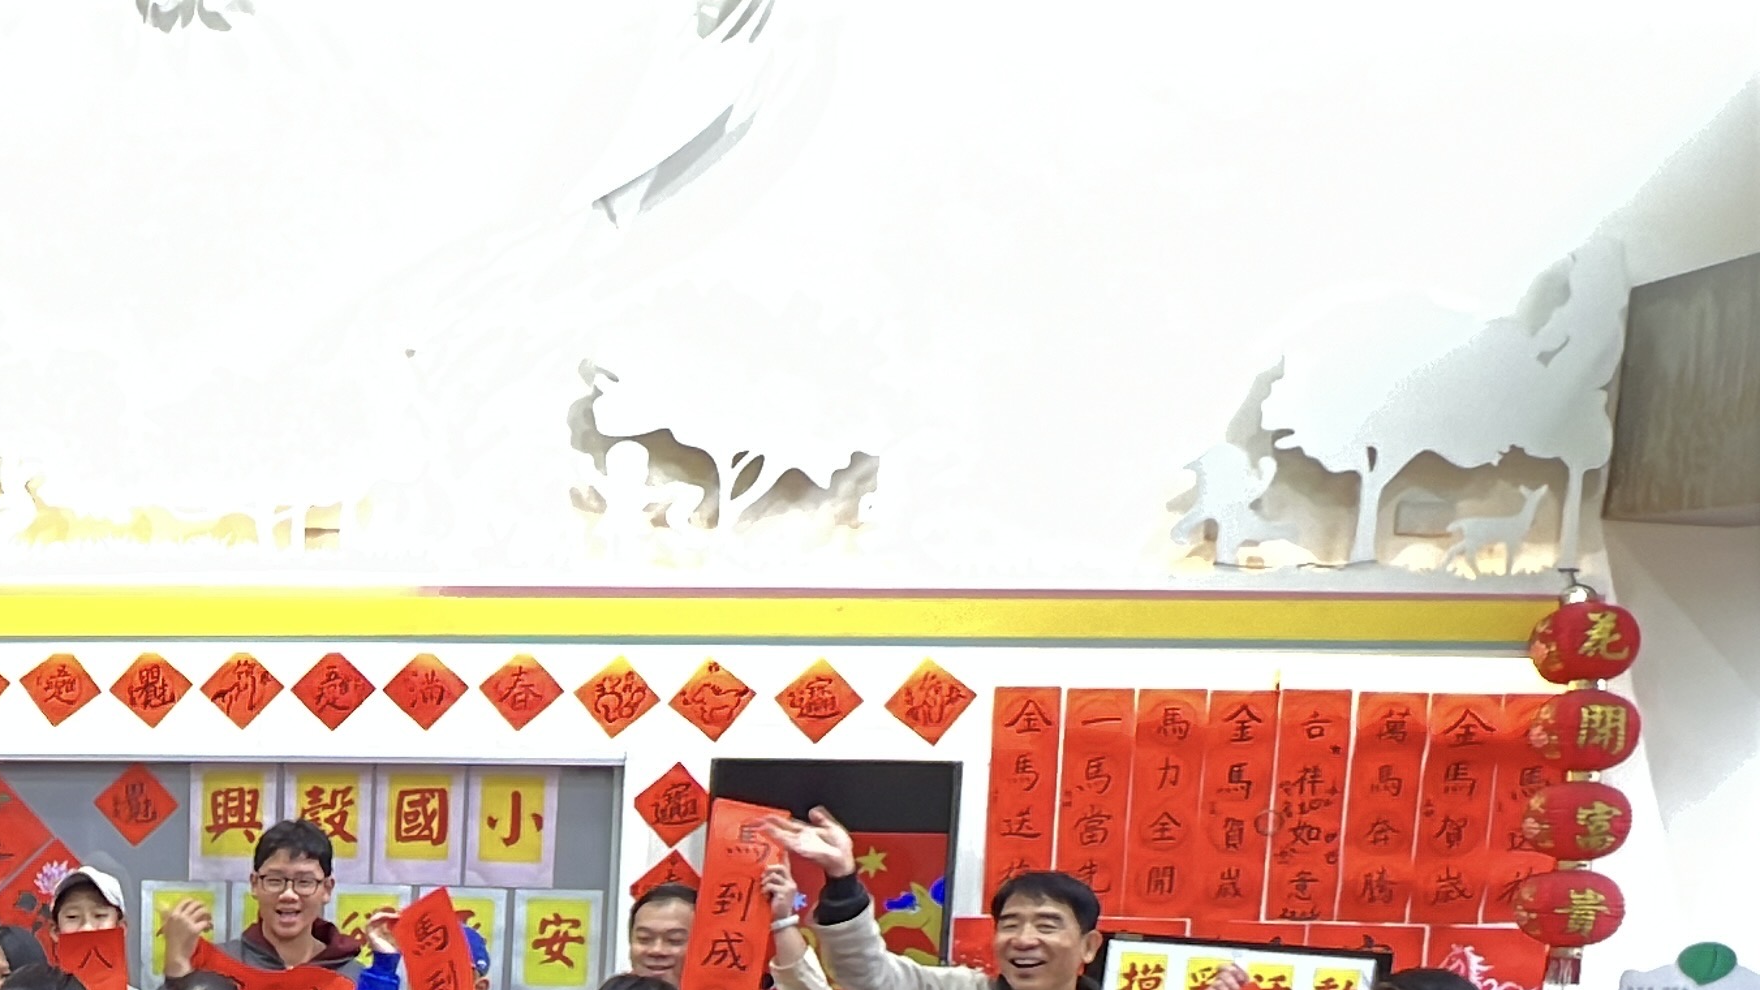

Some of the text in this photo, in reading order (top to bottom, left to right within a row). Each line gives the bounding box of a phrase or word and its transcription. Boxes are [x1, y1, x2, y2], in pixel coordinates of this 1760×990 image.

[500, 665, 544, 711] 春
[1552, 611, 1629, 936] 花開富貴
[1074, 716, 1123, 895] 一馬當先
[1146, 706, 1191, 895] 馬力全開
[1215, 703, 1263, 900] 金馬賀歲
[1289, 710, 1334, 901] 吉祥如意
[1360, 708, 1411, 905] 萬馬奔騰
[1432, 707, 1497, 906] 金馬賀歲
